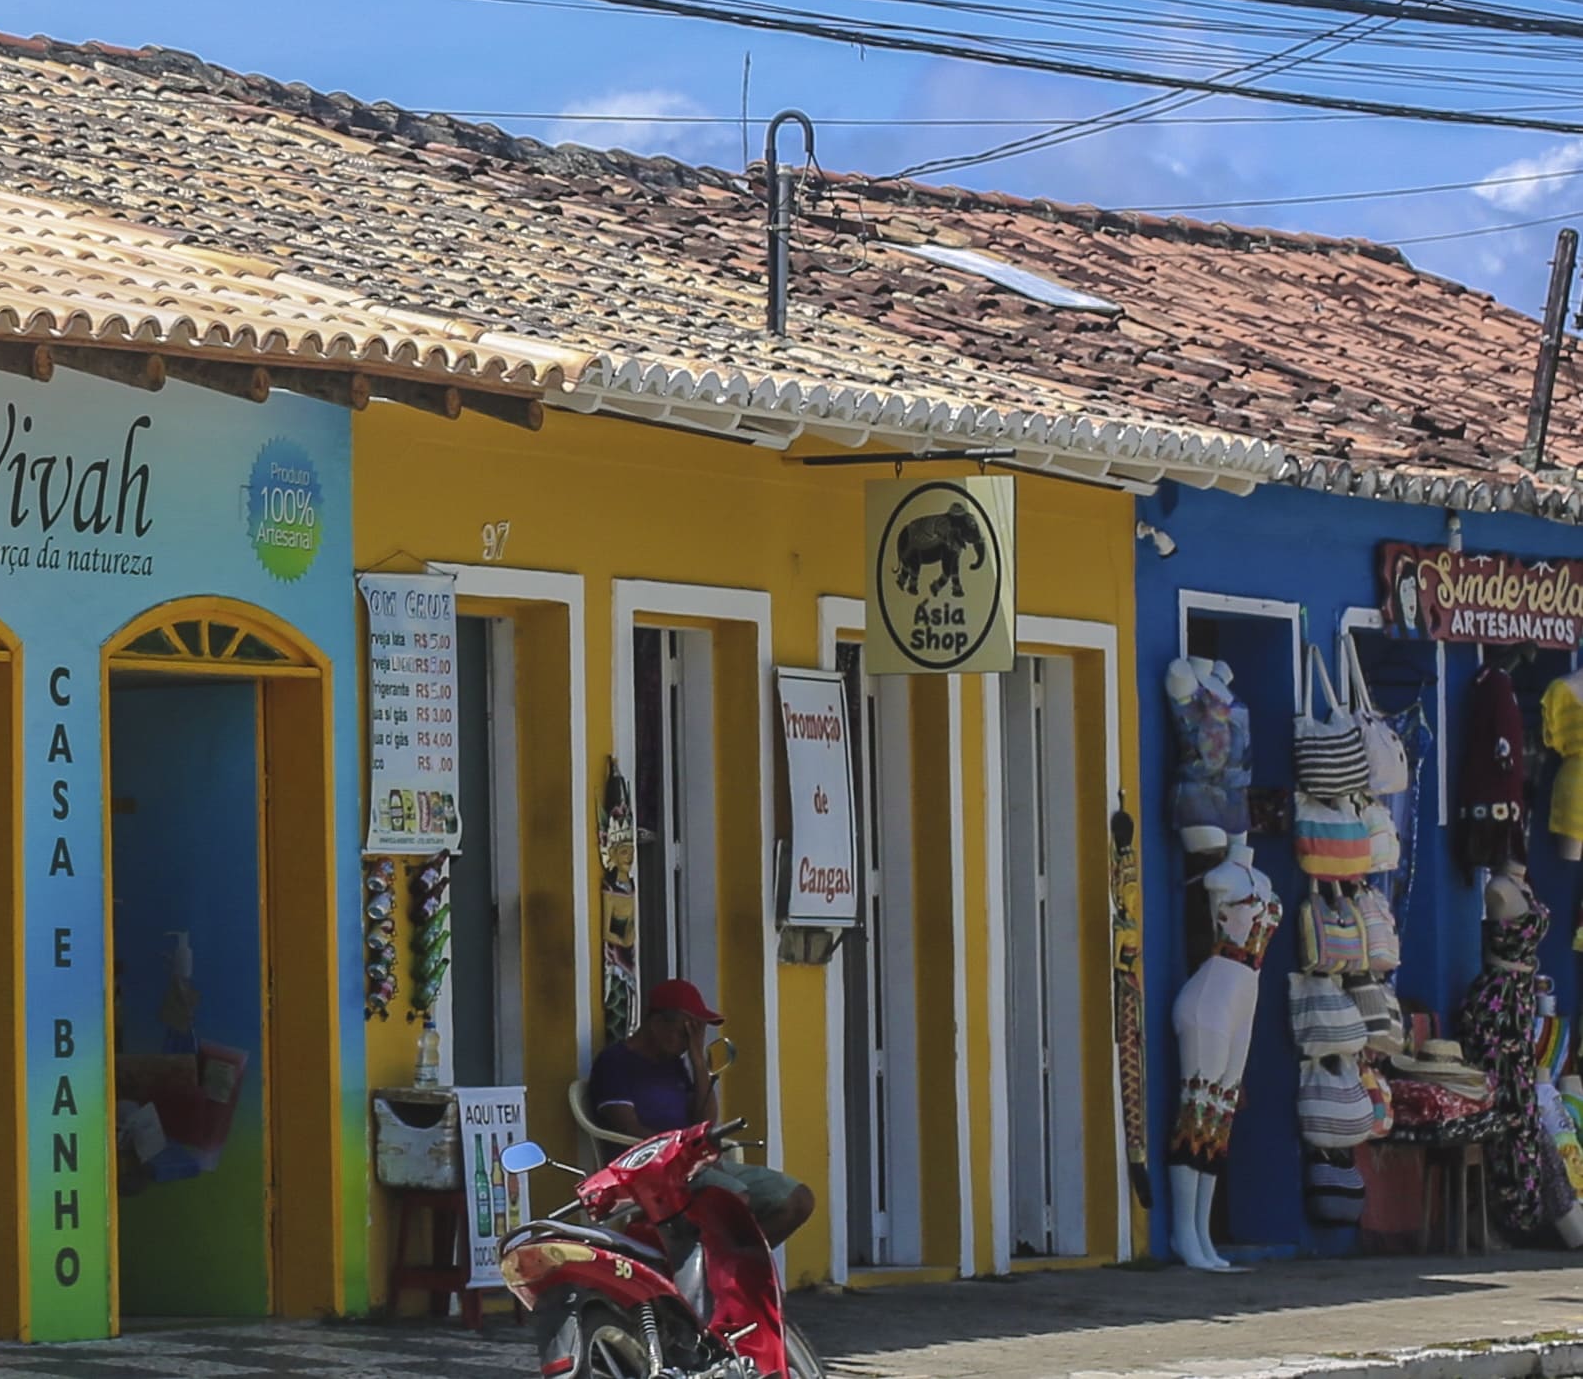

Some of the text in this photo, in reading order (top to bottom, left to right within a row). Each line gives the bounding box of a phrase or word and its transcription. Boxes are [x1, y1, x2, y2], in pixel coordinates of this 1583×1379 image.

[270, 462, 311, 486] Produto
[260, 486, 316, 528] 100%
[255, 521, 314, 551] Artesanal
[482, 521, 510, 561] 97
[36, 535, 61, 569] da
[67, 547, 153, 576] natureza
[913, 598, 966, 626] Ásia
[1451, 608, 1576, 645] ARTESANATOS
[910, 625, 969, 656] Shop
[784, 702, 843, 750] Promoção
[813, 785, 829, 815] de
[799, 856, 851, 904] Cangas
[48, 666, 81, 1288] CASA E BANHO
[465, 1104, 521, 1126] AQUI TEM
[615, 1258, 633, 1279] 50
